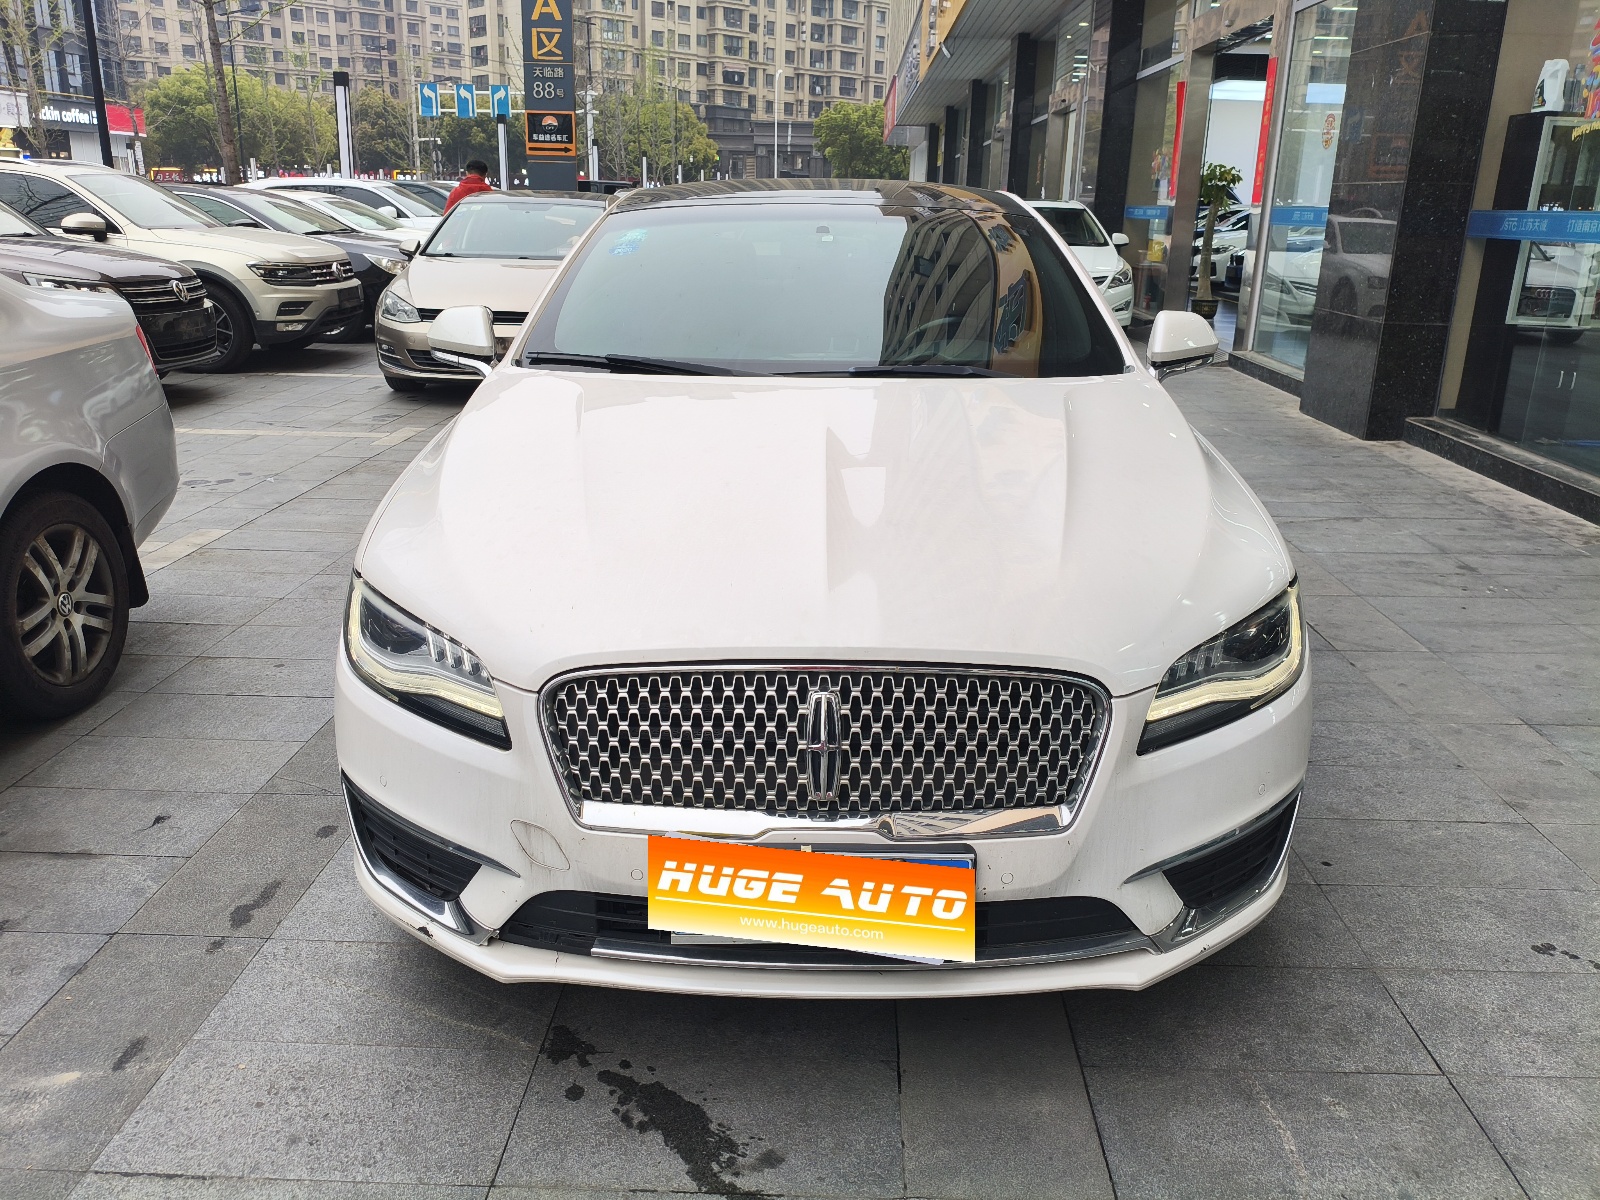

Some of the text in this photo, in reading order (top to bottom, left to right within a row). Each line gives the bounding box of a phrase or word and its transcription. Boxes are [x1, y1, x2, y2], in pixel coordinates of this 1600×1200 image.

[532, 67, 564, 78] 天临路
[533, 82, 565, 99] 88号
[62, 108, 89, 124] coffee
